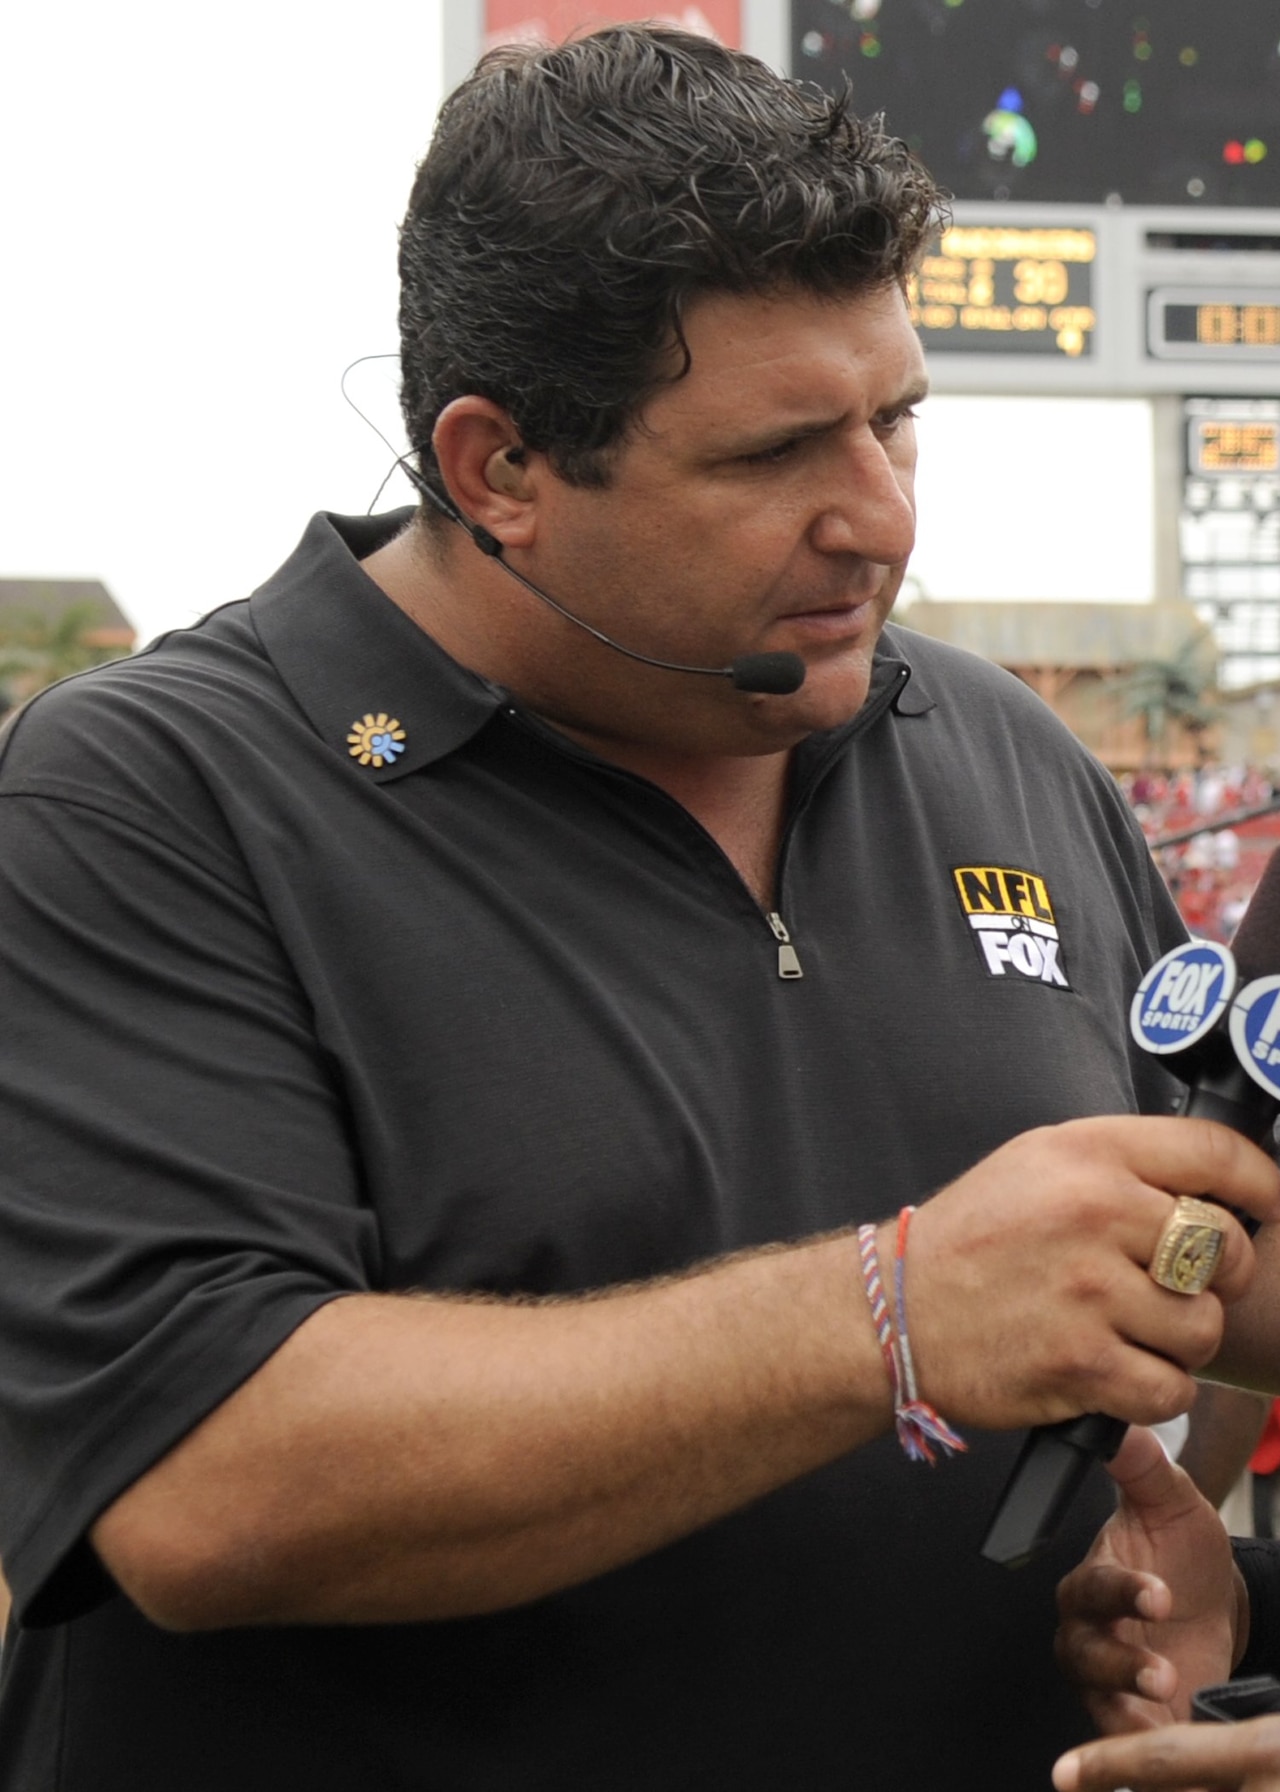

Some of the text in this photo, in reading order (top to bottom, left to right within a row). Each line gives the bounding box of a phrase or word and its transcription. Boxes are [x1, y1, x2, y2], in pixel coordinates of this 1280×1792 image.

[960, 871, 1052, 921] NFL
[978, 930, 1070, 987] FOX
[1148, 961, 1223, 1016] FOX
[1141, 1011, 1201, 1032] SPORTS
